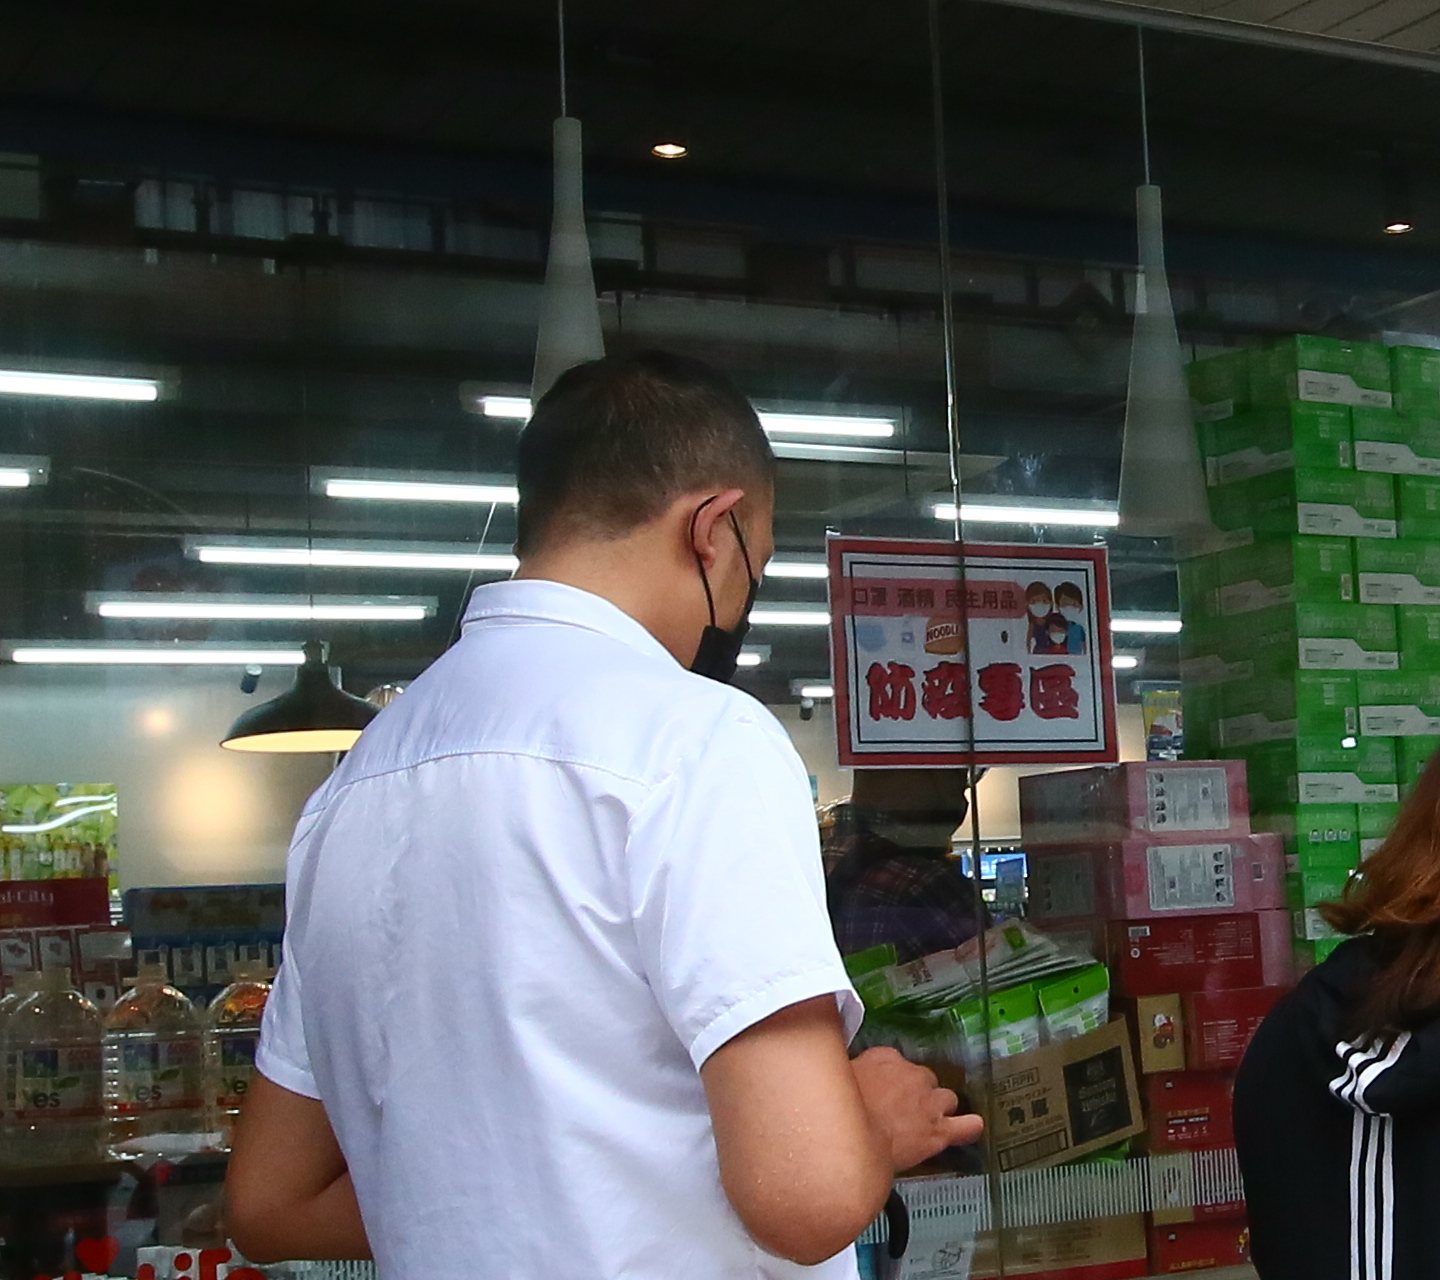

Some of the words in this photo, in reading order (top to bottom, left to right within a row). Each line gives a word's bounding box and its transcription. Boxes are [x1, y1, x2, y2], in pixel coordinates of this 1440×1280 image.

[853, 587, 887, 607] 口罩
[945, 589, 1018, 611] 民生用品
[866, 660, 1080, 722] 防疫專區
[222, 1077, 248, 1095] Ye
